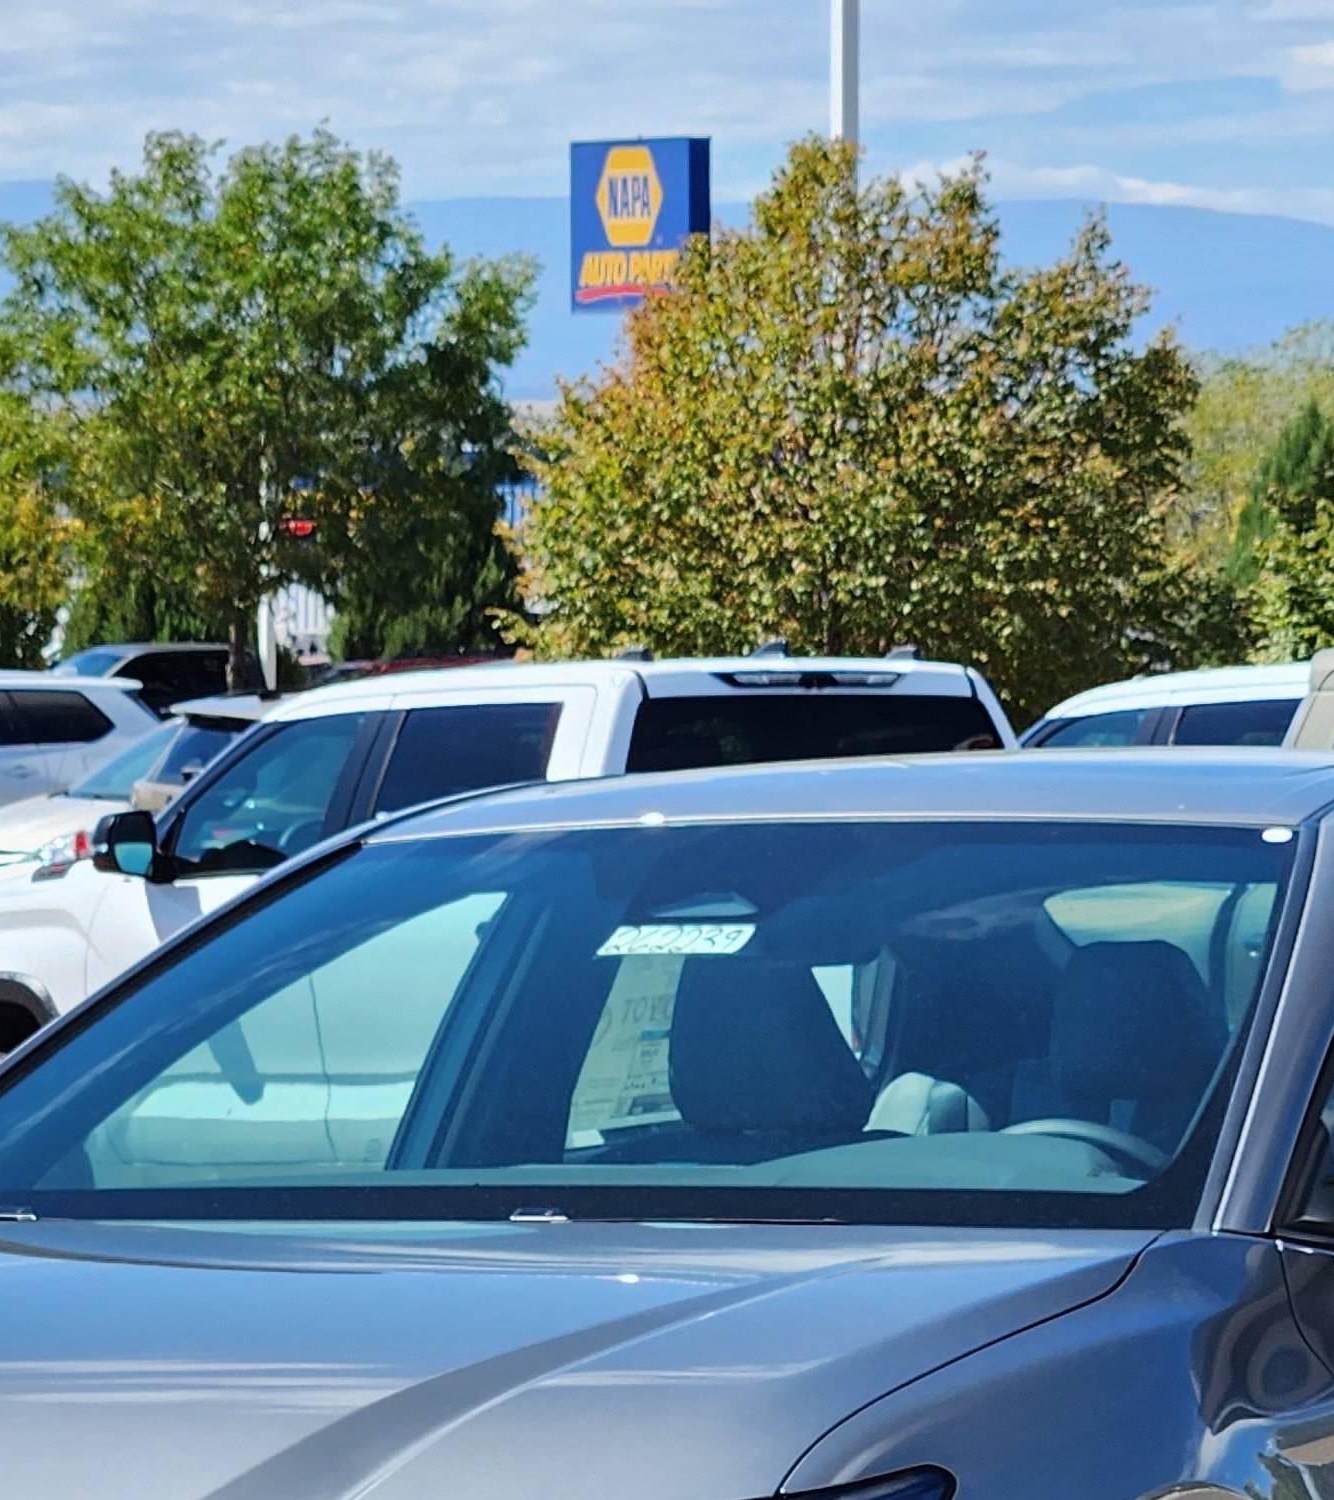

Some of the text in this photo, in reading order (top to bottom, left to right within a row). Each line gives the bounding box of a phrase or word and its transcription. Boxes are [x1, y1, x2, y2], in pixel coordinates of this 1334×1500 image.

[608, 175, 652, 217] NAPA
[579, 250, 681, 287] AUTO PART
